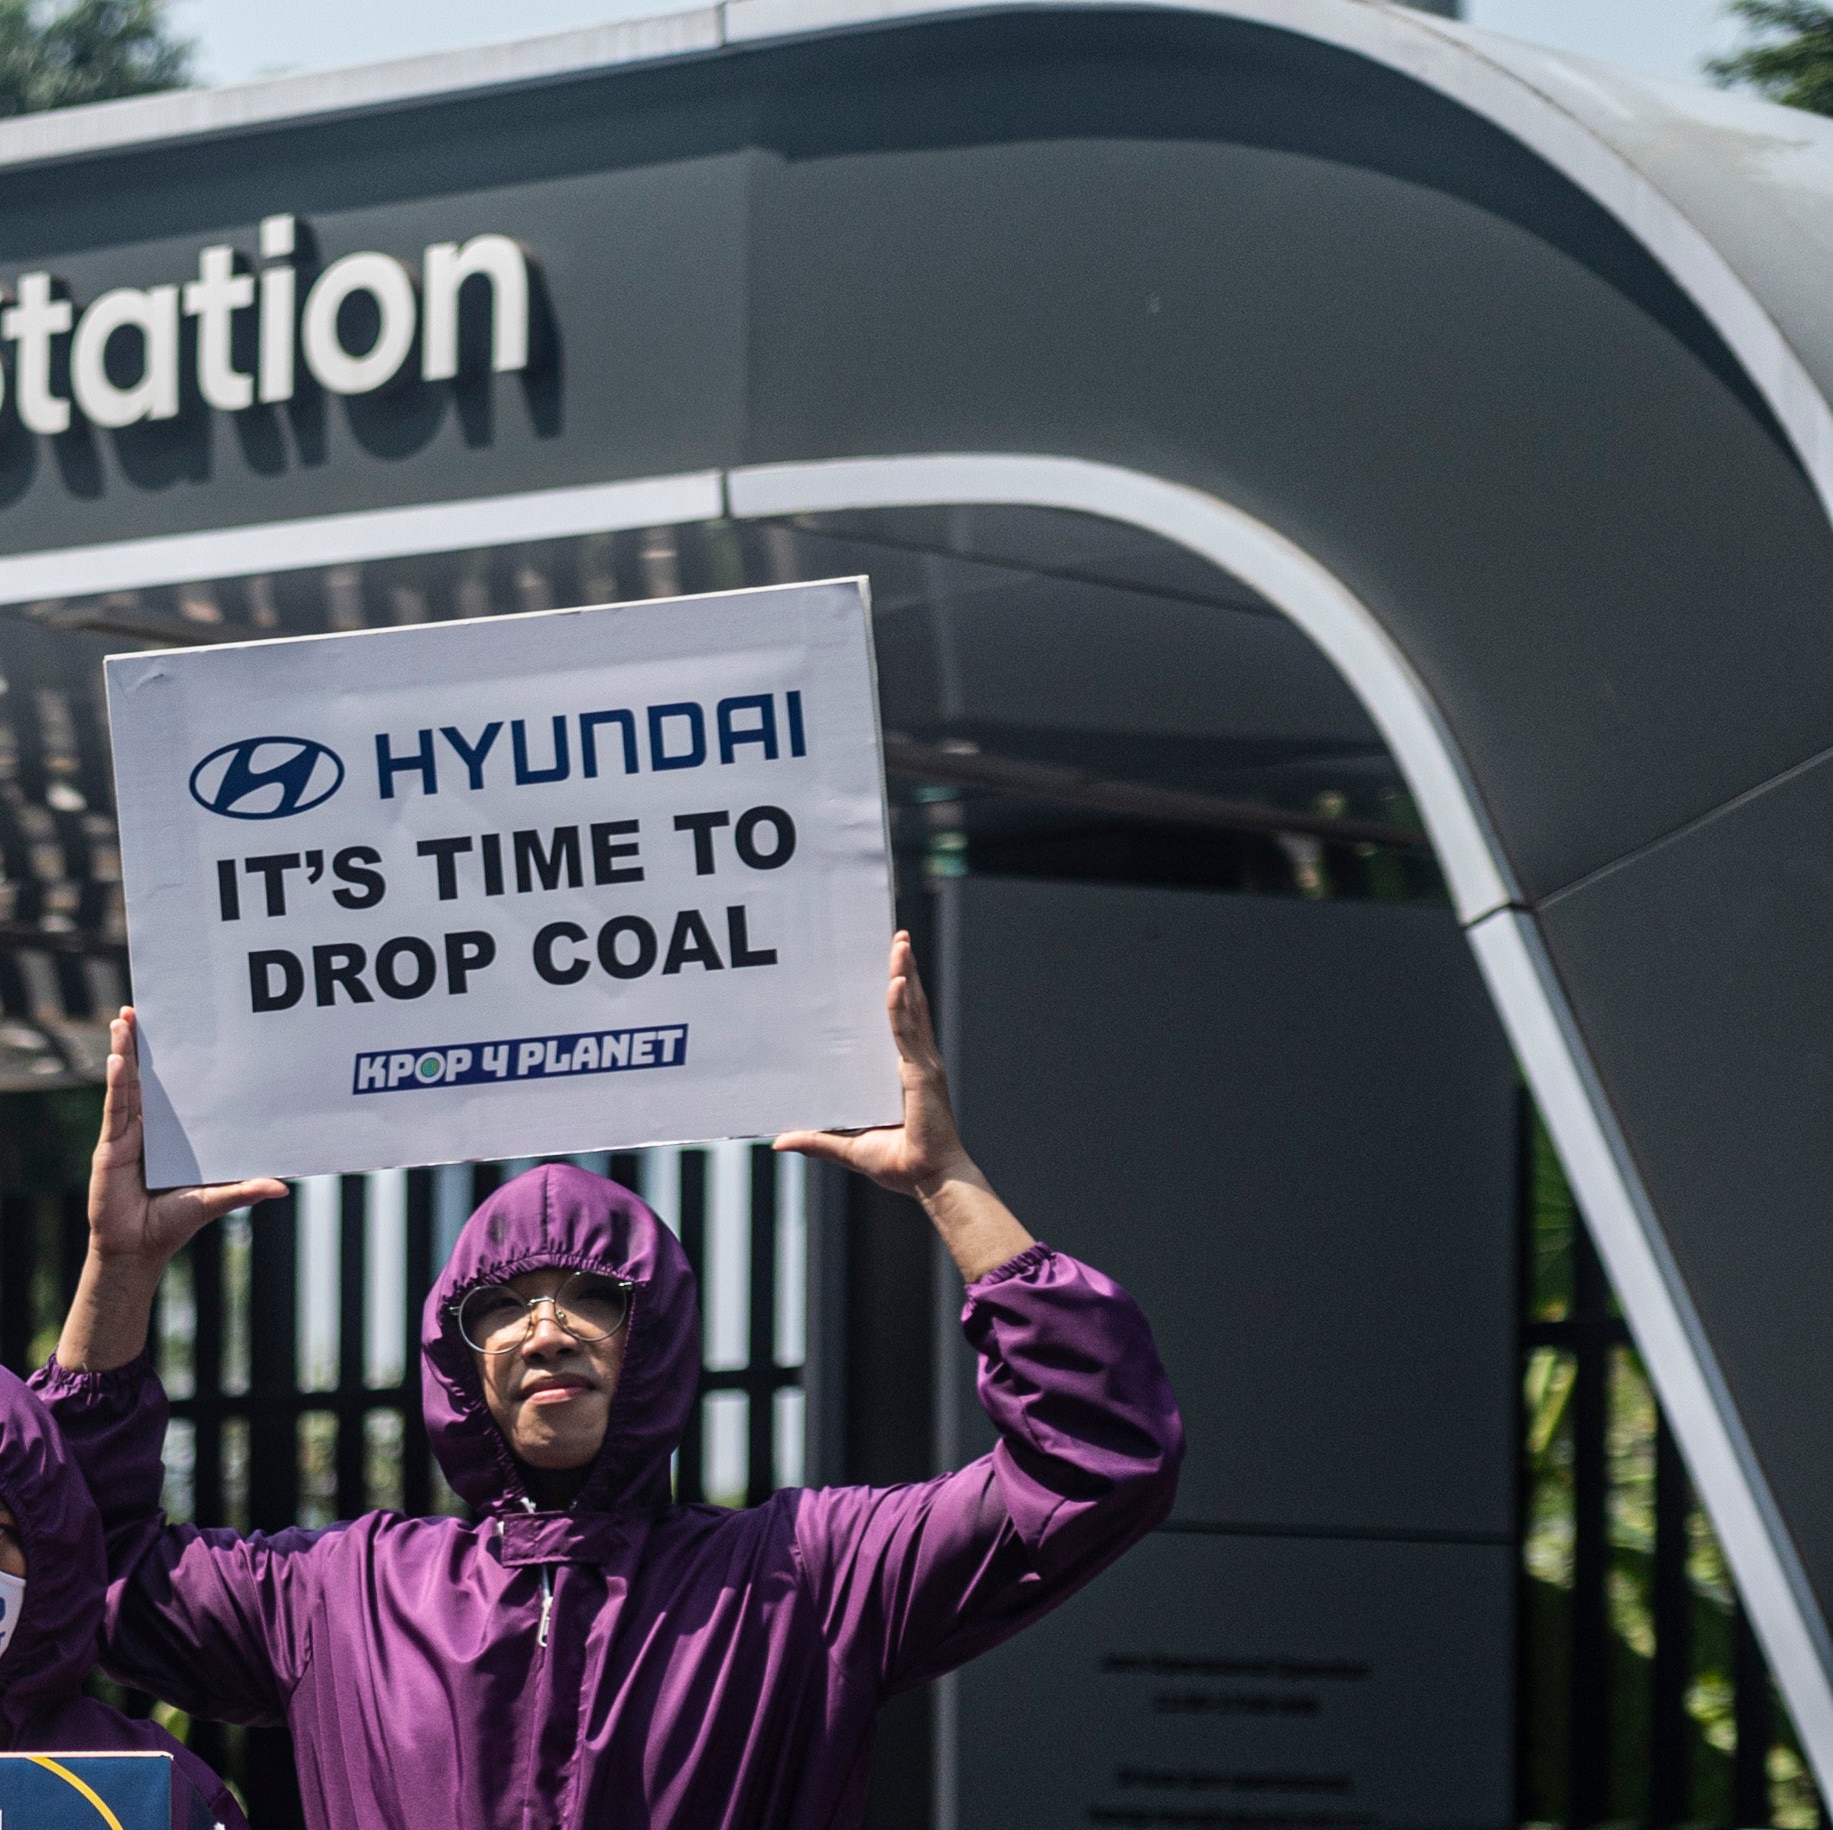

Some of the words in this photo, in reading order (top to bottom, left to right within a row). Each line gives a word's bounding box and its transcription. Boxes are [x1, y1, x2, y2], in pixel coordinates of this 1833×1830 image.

[375, 690, 808, 800] HYUNDAI
[216, 845, 387, 922] IT'S
[417, 819, 644, 902] TIME
[673, 805, 797, 876] TO
[247, 929, 497, 1014] DROP
[532, 904, 778, 987] COAL
[357, 1049, 472, 1090] KPOP
[482, 1045, 509, 1077] 4
[516, 1028, 684, 1076] PLANET
